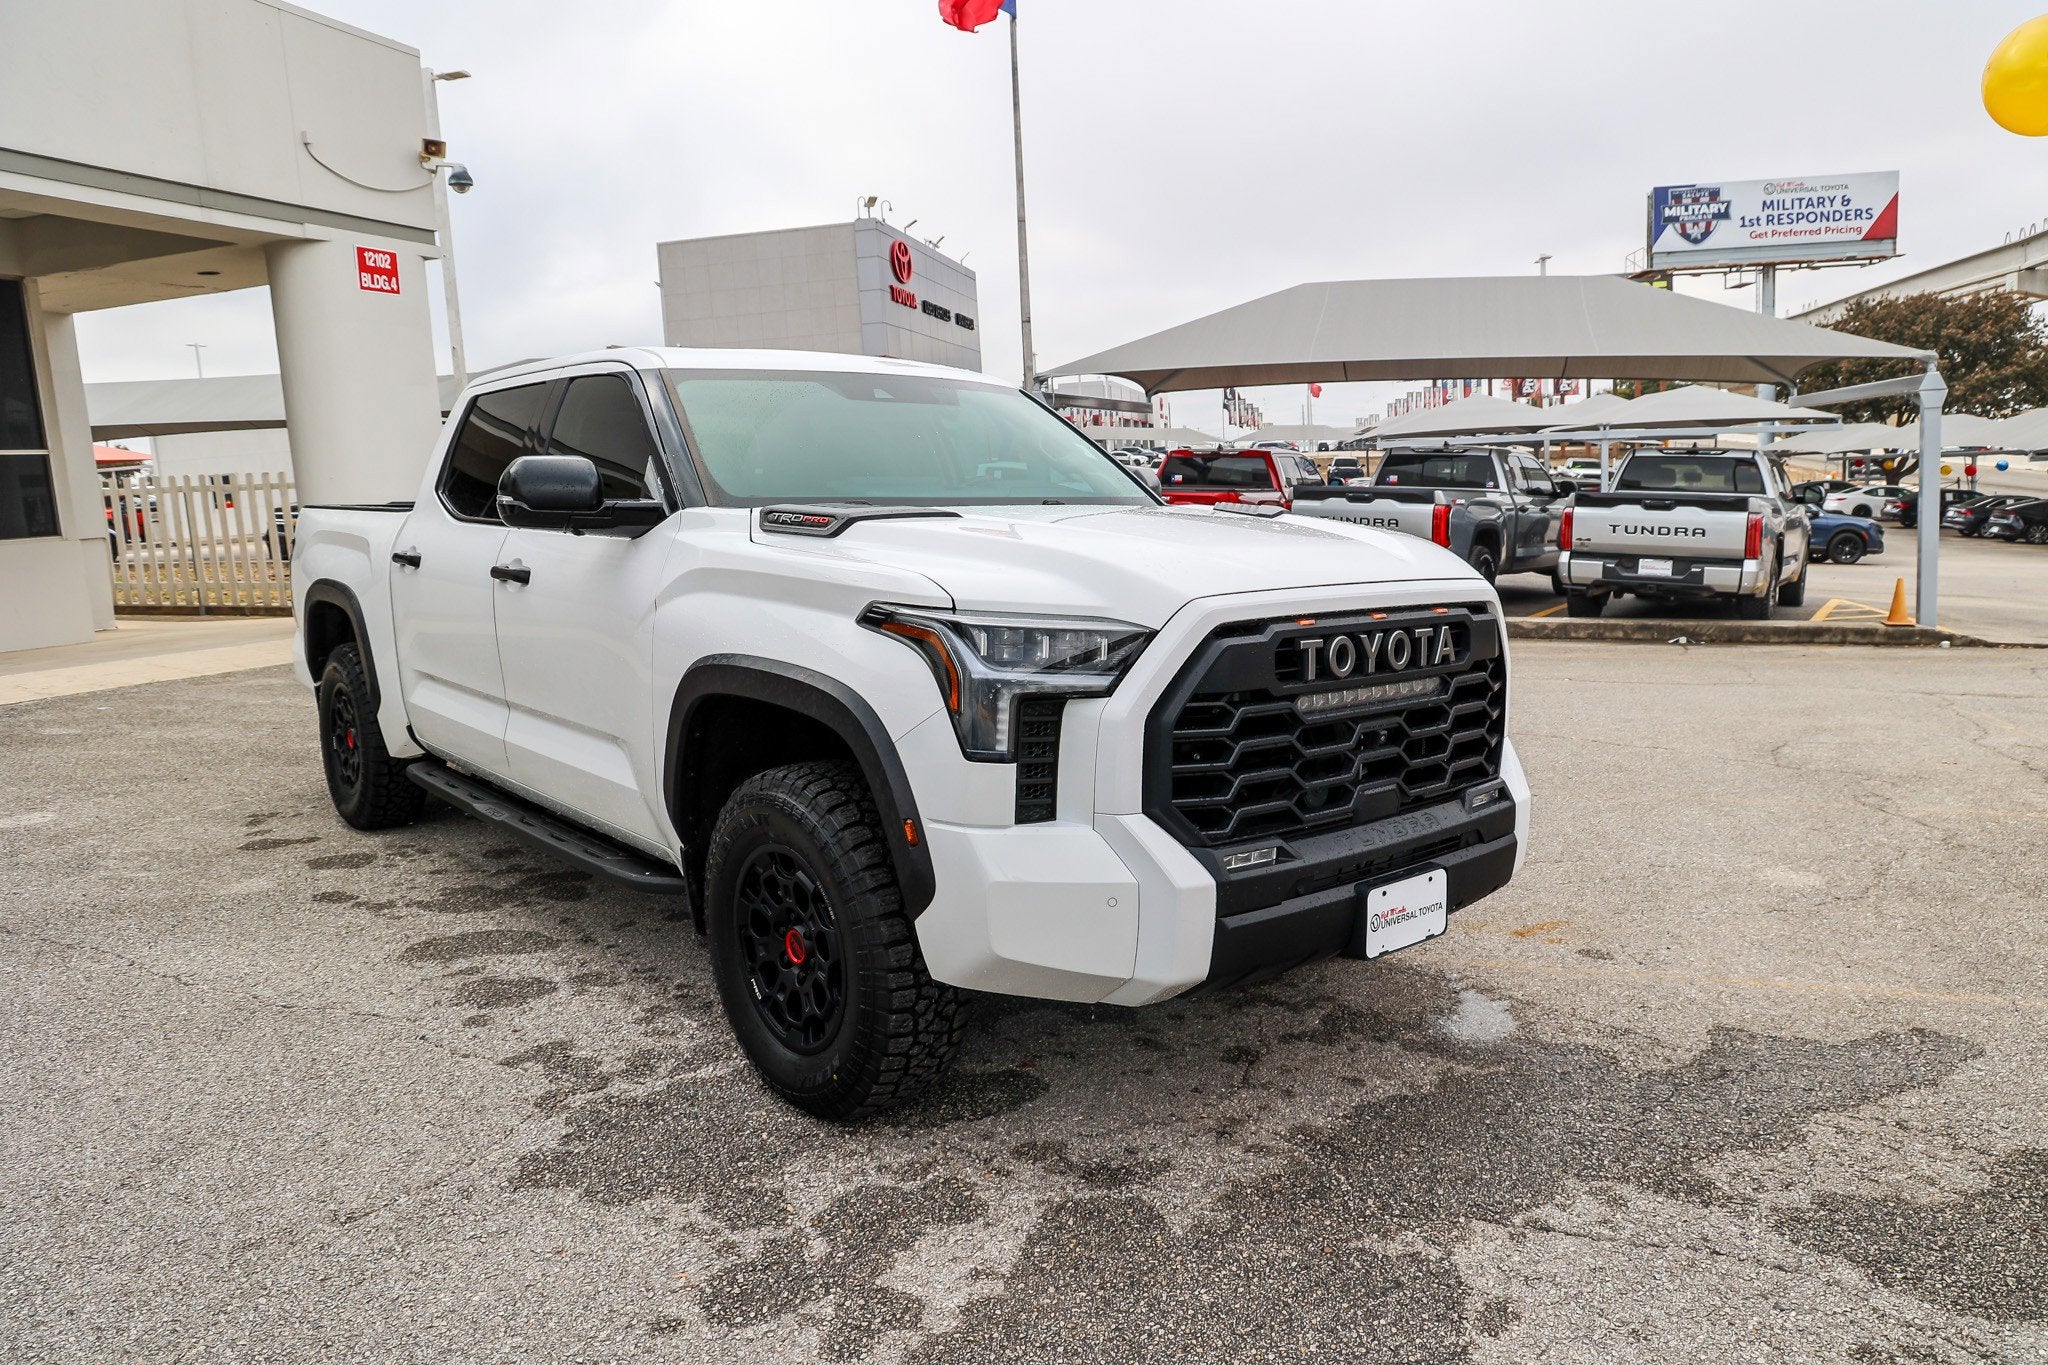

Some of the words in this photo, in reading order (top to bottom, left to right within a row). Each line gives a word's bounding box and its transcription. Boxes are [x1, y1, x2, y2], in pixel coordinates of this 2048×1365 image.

[1776, 186, 1819, 195] UNIVERSAL
[1820, 184, 1849, 192] TOYOTA
[1664, 202, 1728, 218] MILITARY
[1762, 195, 1837, 212] MILITARY
[1841, 194, 1852, 207] &
[1740, 215, 1761, 228] 1st
[1766, 207, 1874, 226] RESPONDERS
[1749, 230, 1768, 240] Get
[1771, 226, 1822, 238] Preferred
[1824, 225, 1863, 236] Pricing
[363, 251, 392, 269] 12102
[772, 512, 804, 524] TRD
[803, 515, 830, 524] PRO
[1608, 524, 1706, 538] TUNDRA
[1299, 625, 1457, 682] TOYOTA
[1380, 910, 1418, 930] UNIVERSAL
[1418, 901, 1444, 917] TOYOTA
